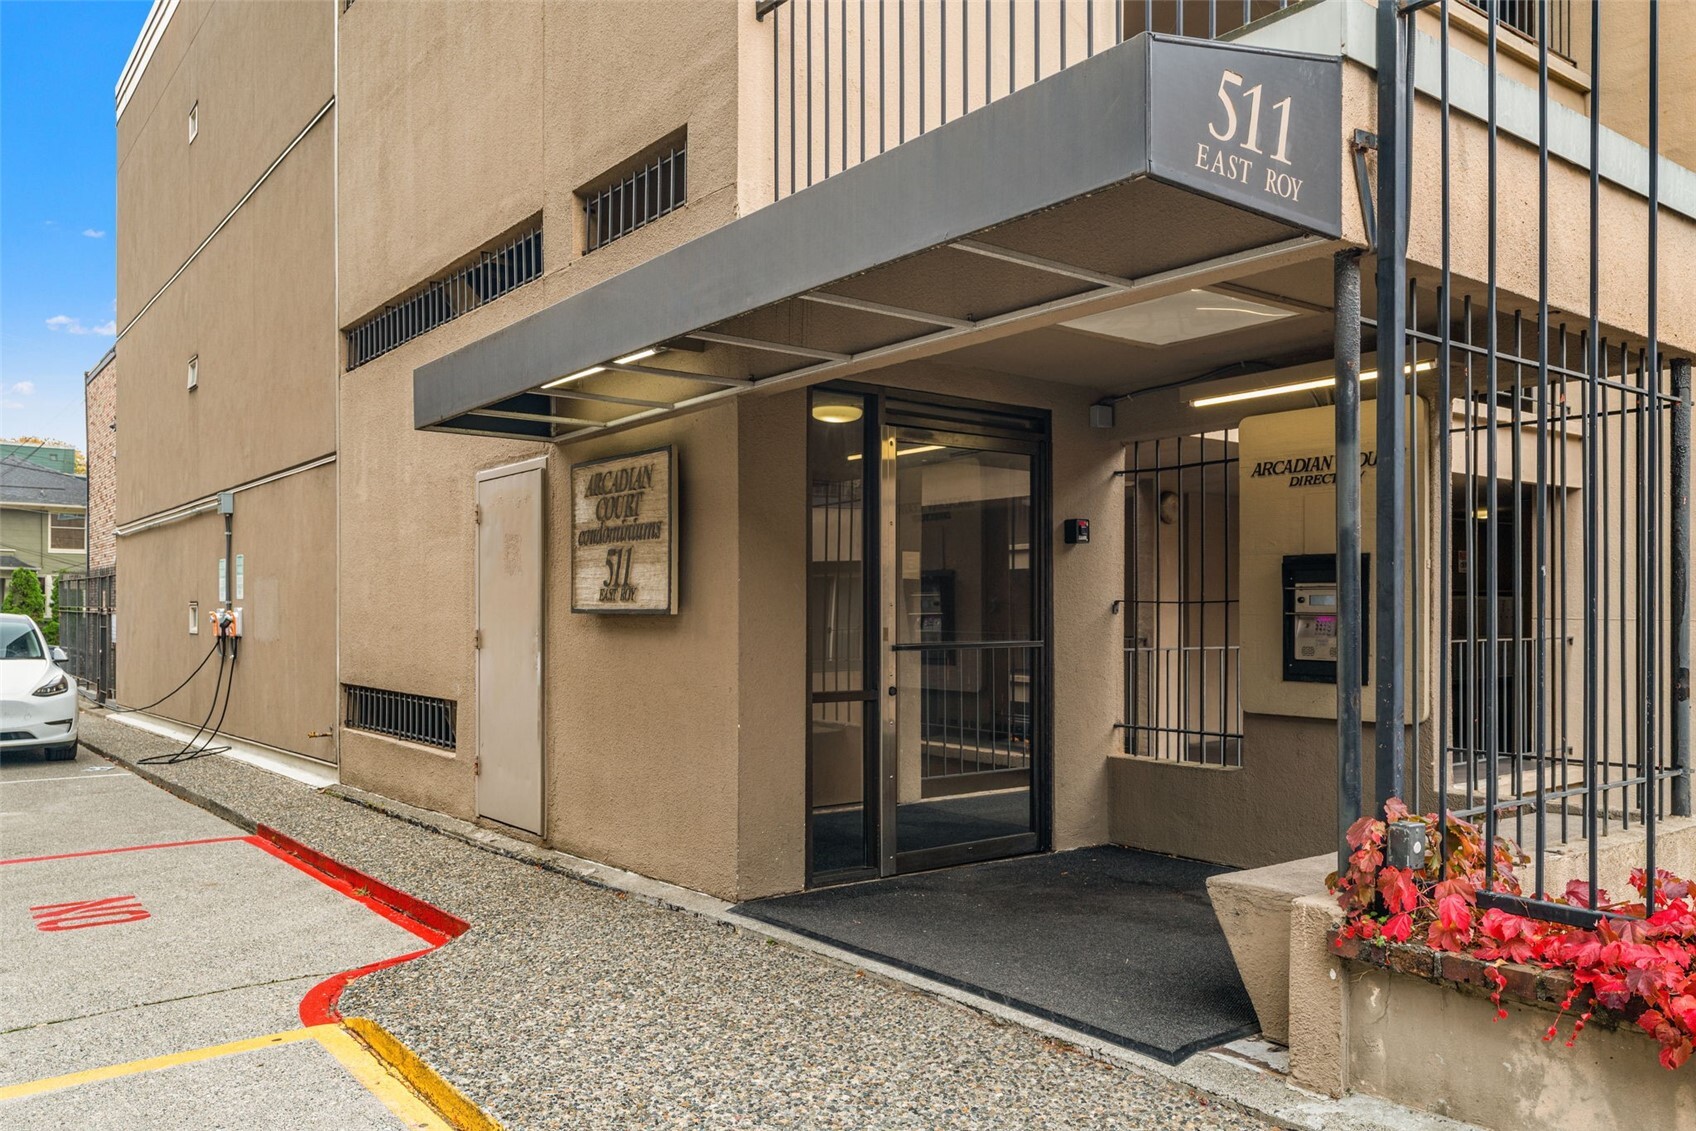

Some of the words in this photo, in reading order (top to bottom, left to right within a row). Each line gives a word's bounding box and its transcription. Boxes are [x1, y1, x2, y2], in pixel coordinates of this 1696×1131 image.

[1208, 69, 1292, 165] 511
[1195, 142, 1253, 184] EAST
[1264, 168, 1304, 202] ROY
[584, 463, 655, 498] ARCADIAN
[1251, 454, 1334, 477] ARCADIAN
[596, 491, 645, 522] COURT
[578, 517, 663, 546] condominiums
[603, 545, 634, 587] 511
[599, 587, 619, 601] EAST
[620, 586, 637, 602] ROY
